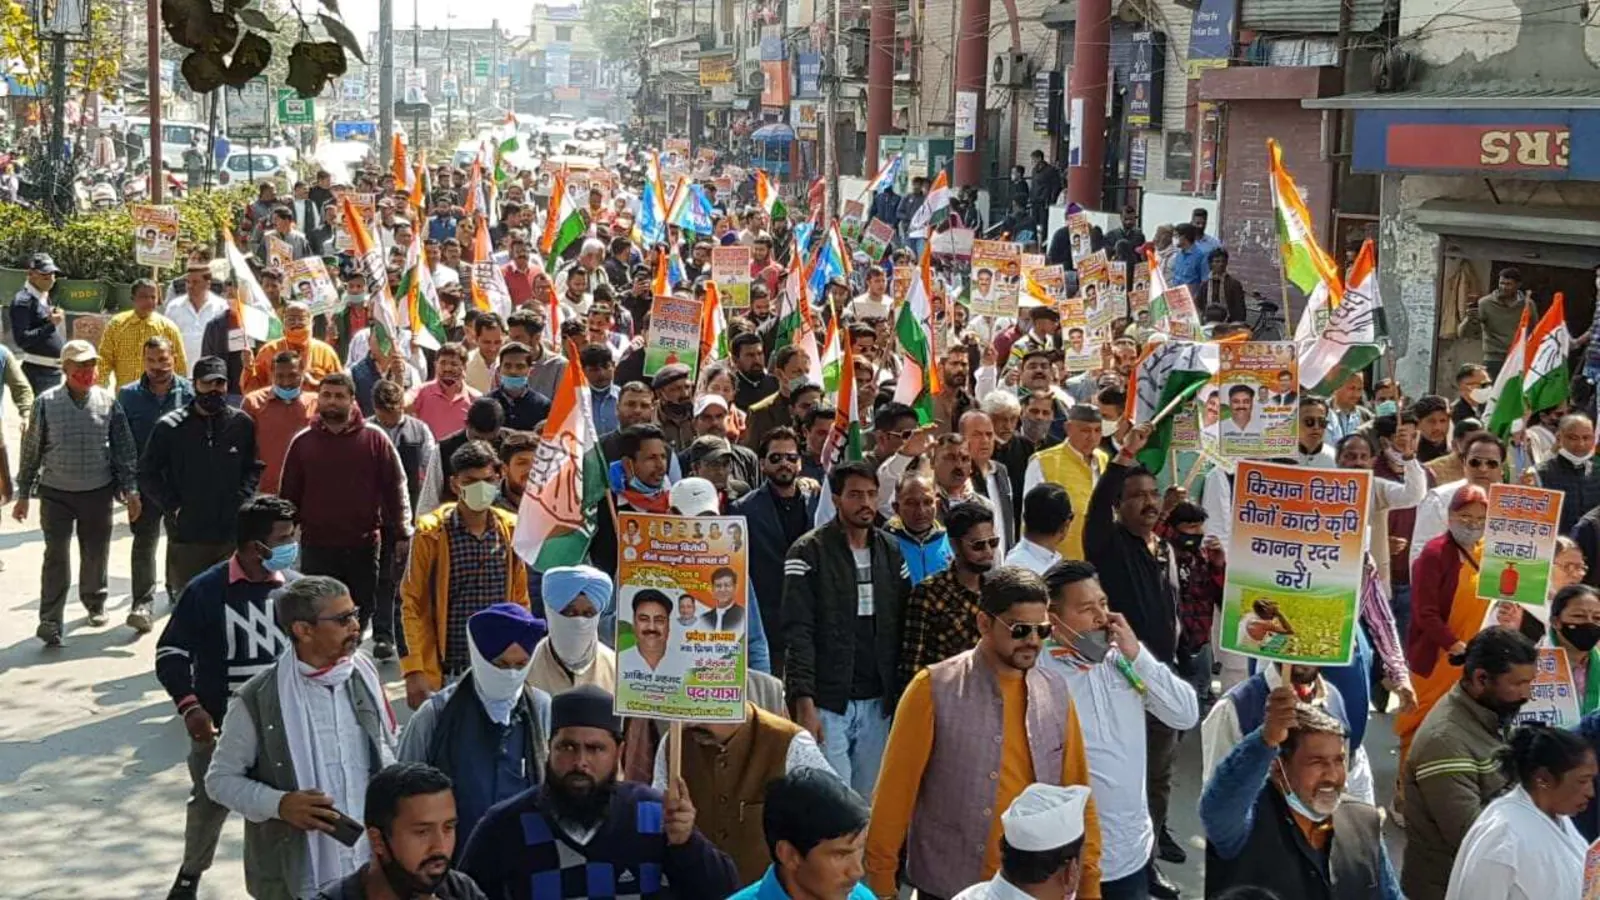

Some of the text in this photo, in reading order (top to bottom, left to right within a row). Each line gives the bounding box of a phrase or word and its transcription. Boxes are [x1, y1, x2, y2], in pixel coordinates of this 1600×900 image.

[1246, 471, 1358, 504] किसान विरोधी
[1239, 500, 1280, 526] तीनों
[1281, 509, 1320, 532] काले
